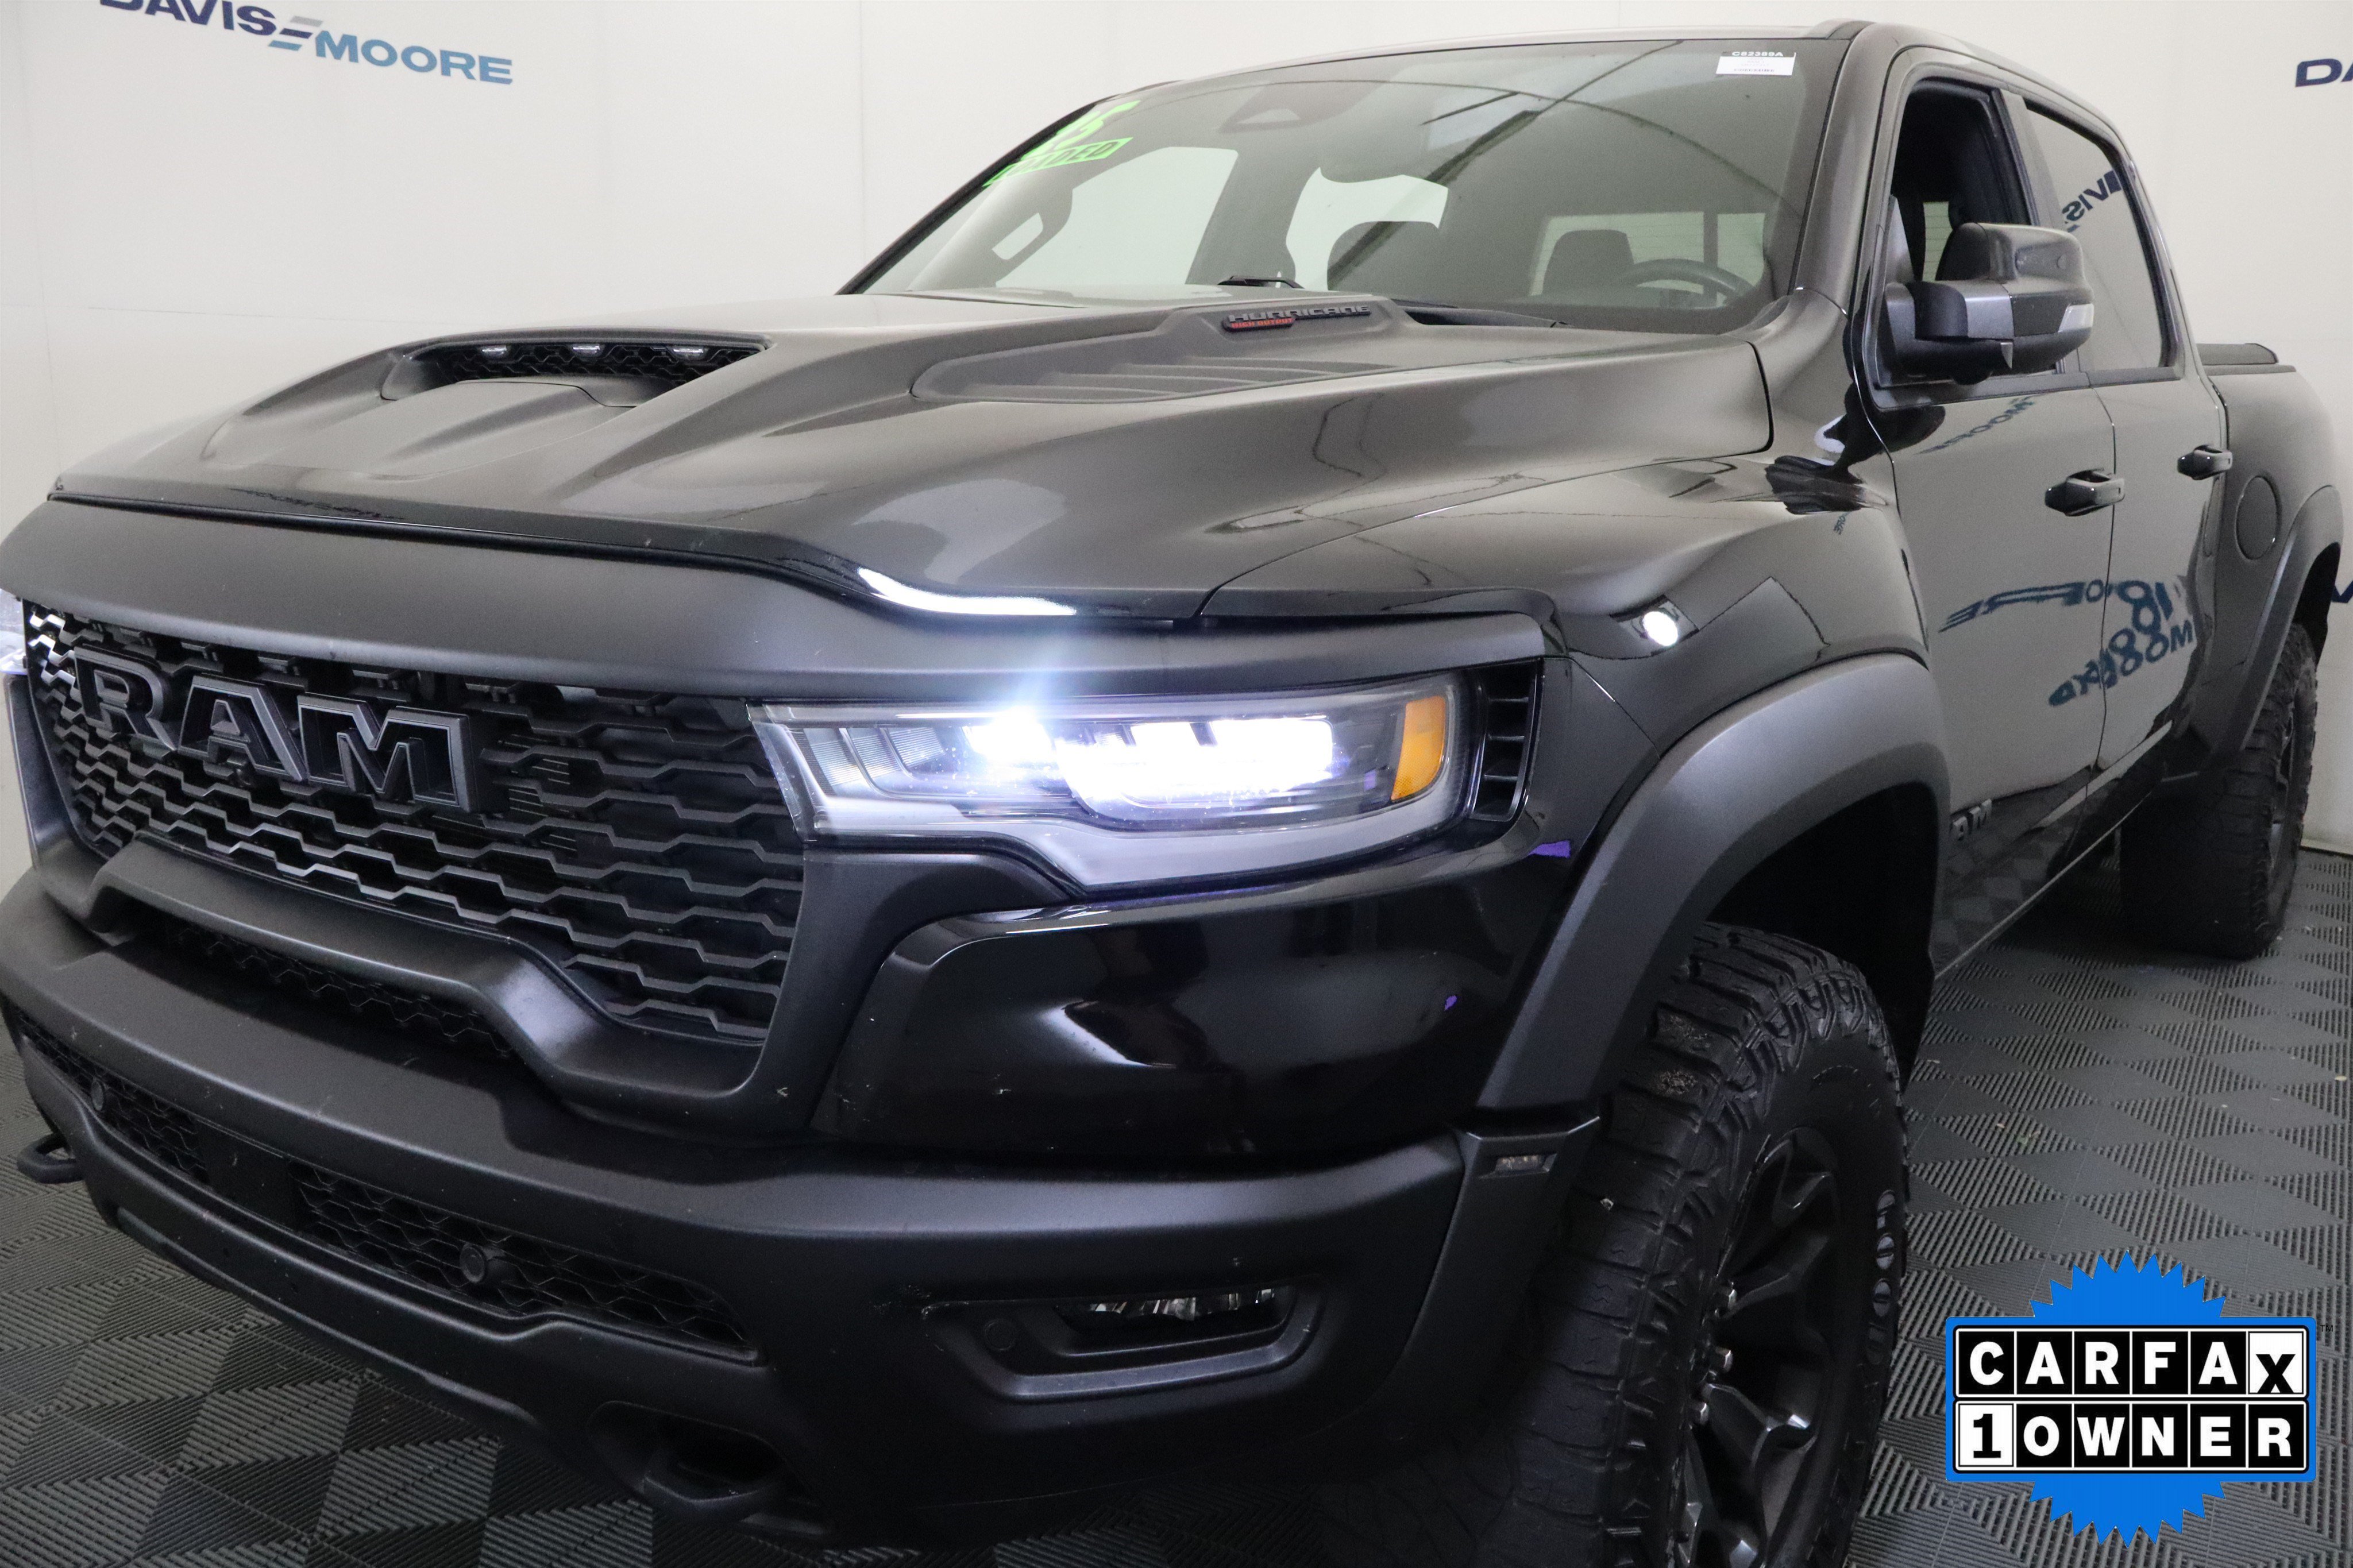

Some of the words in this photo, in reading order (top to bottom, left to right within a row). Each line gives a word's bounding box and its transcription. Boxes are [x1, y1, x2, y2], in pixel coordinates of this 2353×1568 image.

[315, 30, 513, 85] MOORE
[2295, 58, 2353, 87] D
[1229, 306, 1371, 322] HURRICANE
[73, 644, 471, 811] RAM
